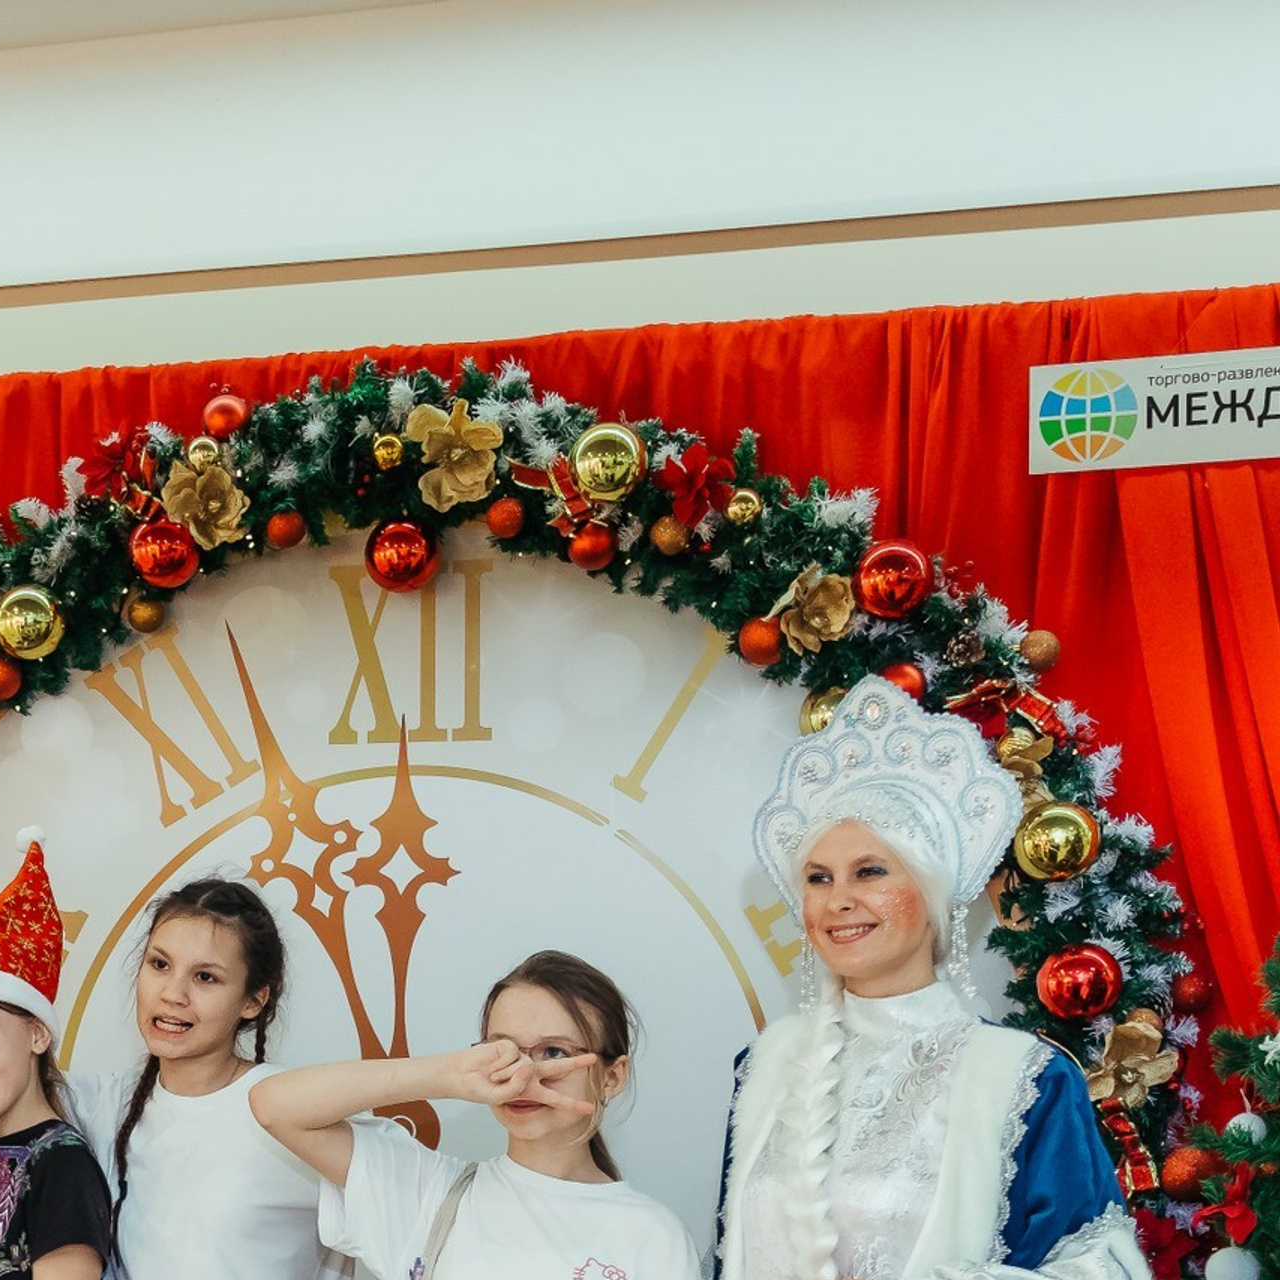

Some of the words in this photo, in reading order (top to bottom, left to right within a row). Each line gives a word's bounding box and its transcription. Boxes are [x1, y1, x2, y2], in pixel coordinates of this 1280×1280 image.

[1146, 386, 1280, 429] МЕЖД
[84, 624, 262, 829] XI
[328, 559, 494, 745] XII
